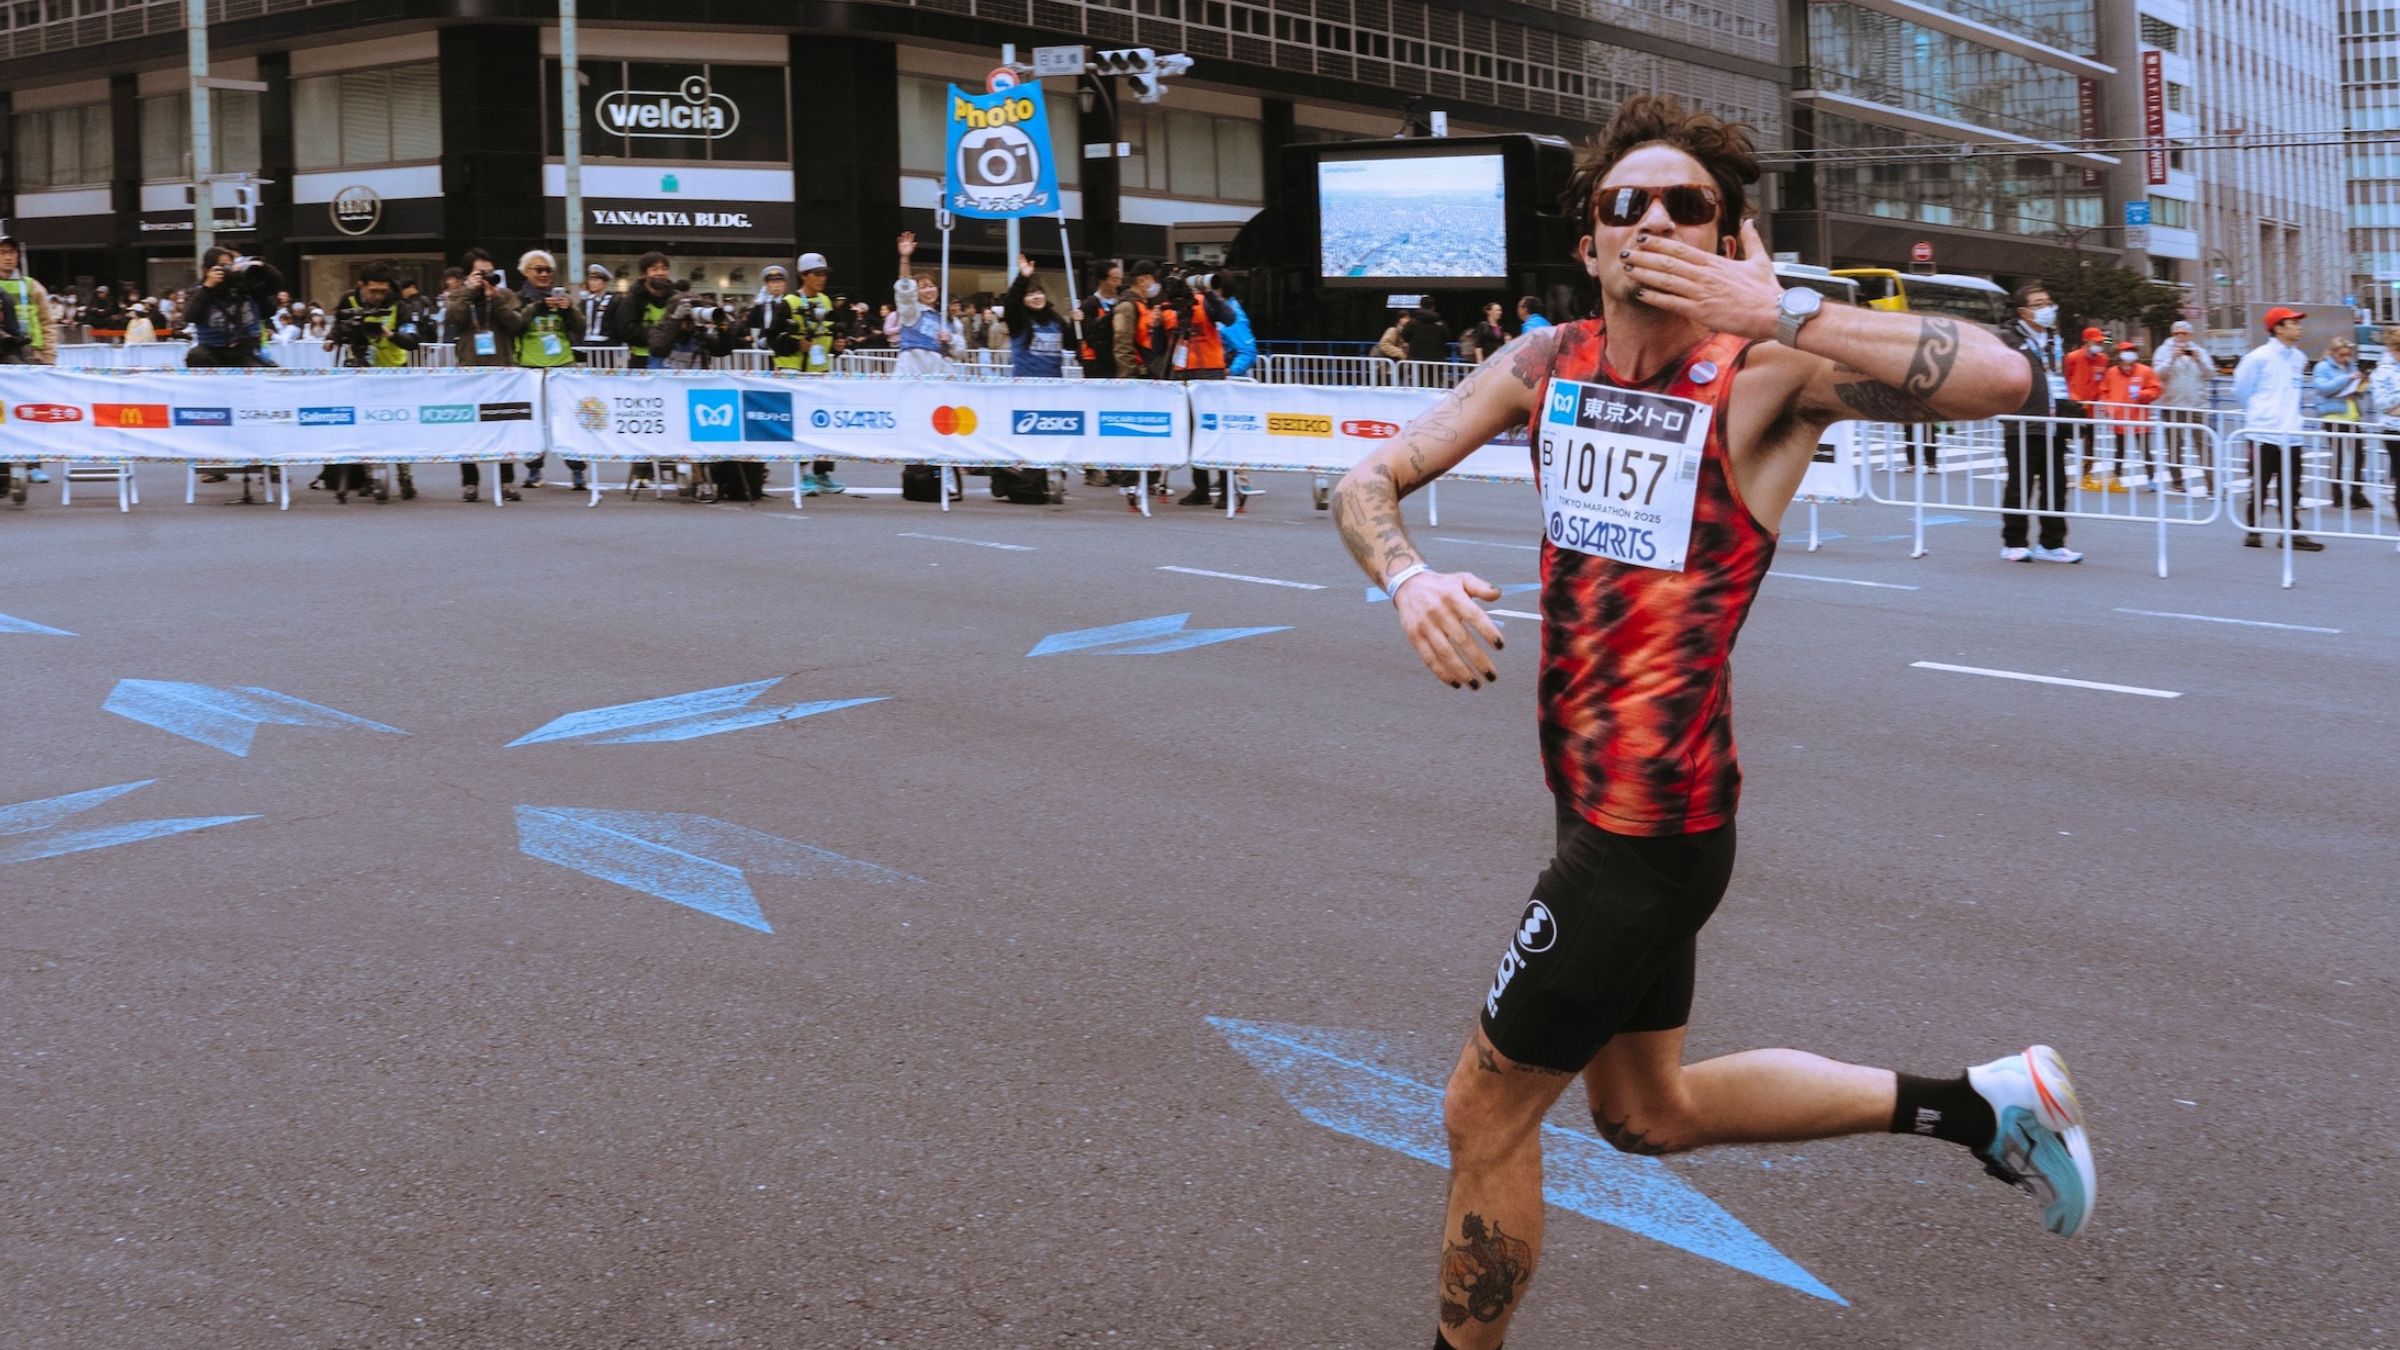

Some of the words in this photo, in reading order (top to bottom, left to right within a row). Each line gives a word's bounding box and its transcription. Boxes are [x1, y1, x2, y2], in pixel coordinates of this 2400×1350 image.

[608, 98, 725, 130] welcia
[954, 97, 1035, 129] Photo
[954, 192, 1049, 211] オールスポーツ
[592, 210, 691, 227] YANAGIYA
[694, 212, 753, 228] BLDG.
[613, 397, 664, 409] TOKYO
[1583, 398, 1684, 432] 東京メトロ
[614, 419, 667, 434] 2025
[832, 410, 897, 430] STARTS
[1036, 416, 1079, 431] asics
[1267, 416, 1332, 434] SEIKO
[1542, 439, 1553, 467] B
[1563, 439, 1669, 506] 10157
[1558, 495, 1582, 510] TOKYO
[1583, 502, 1632, 519] MARATHON
[1633, 510, 1662, 524] 2025
[1566, 515, 1657, 562] STARTS
